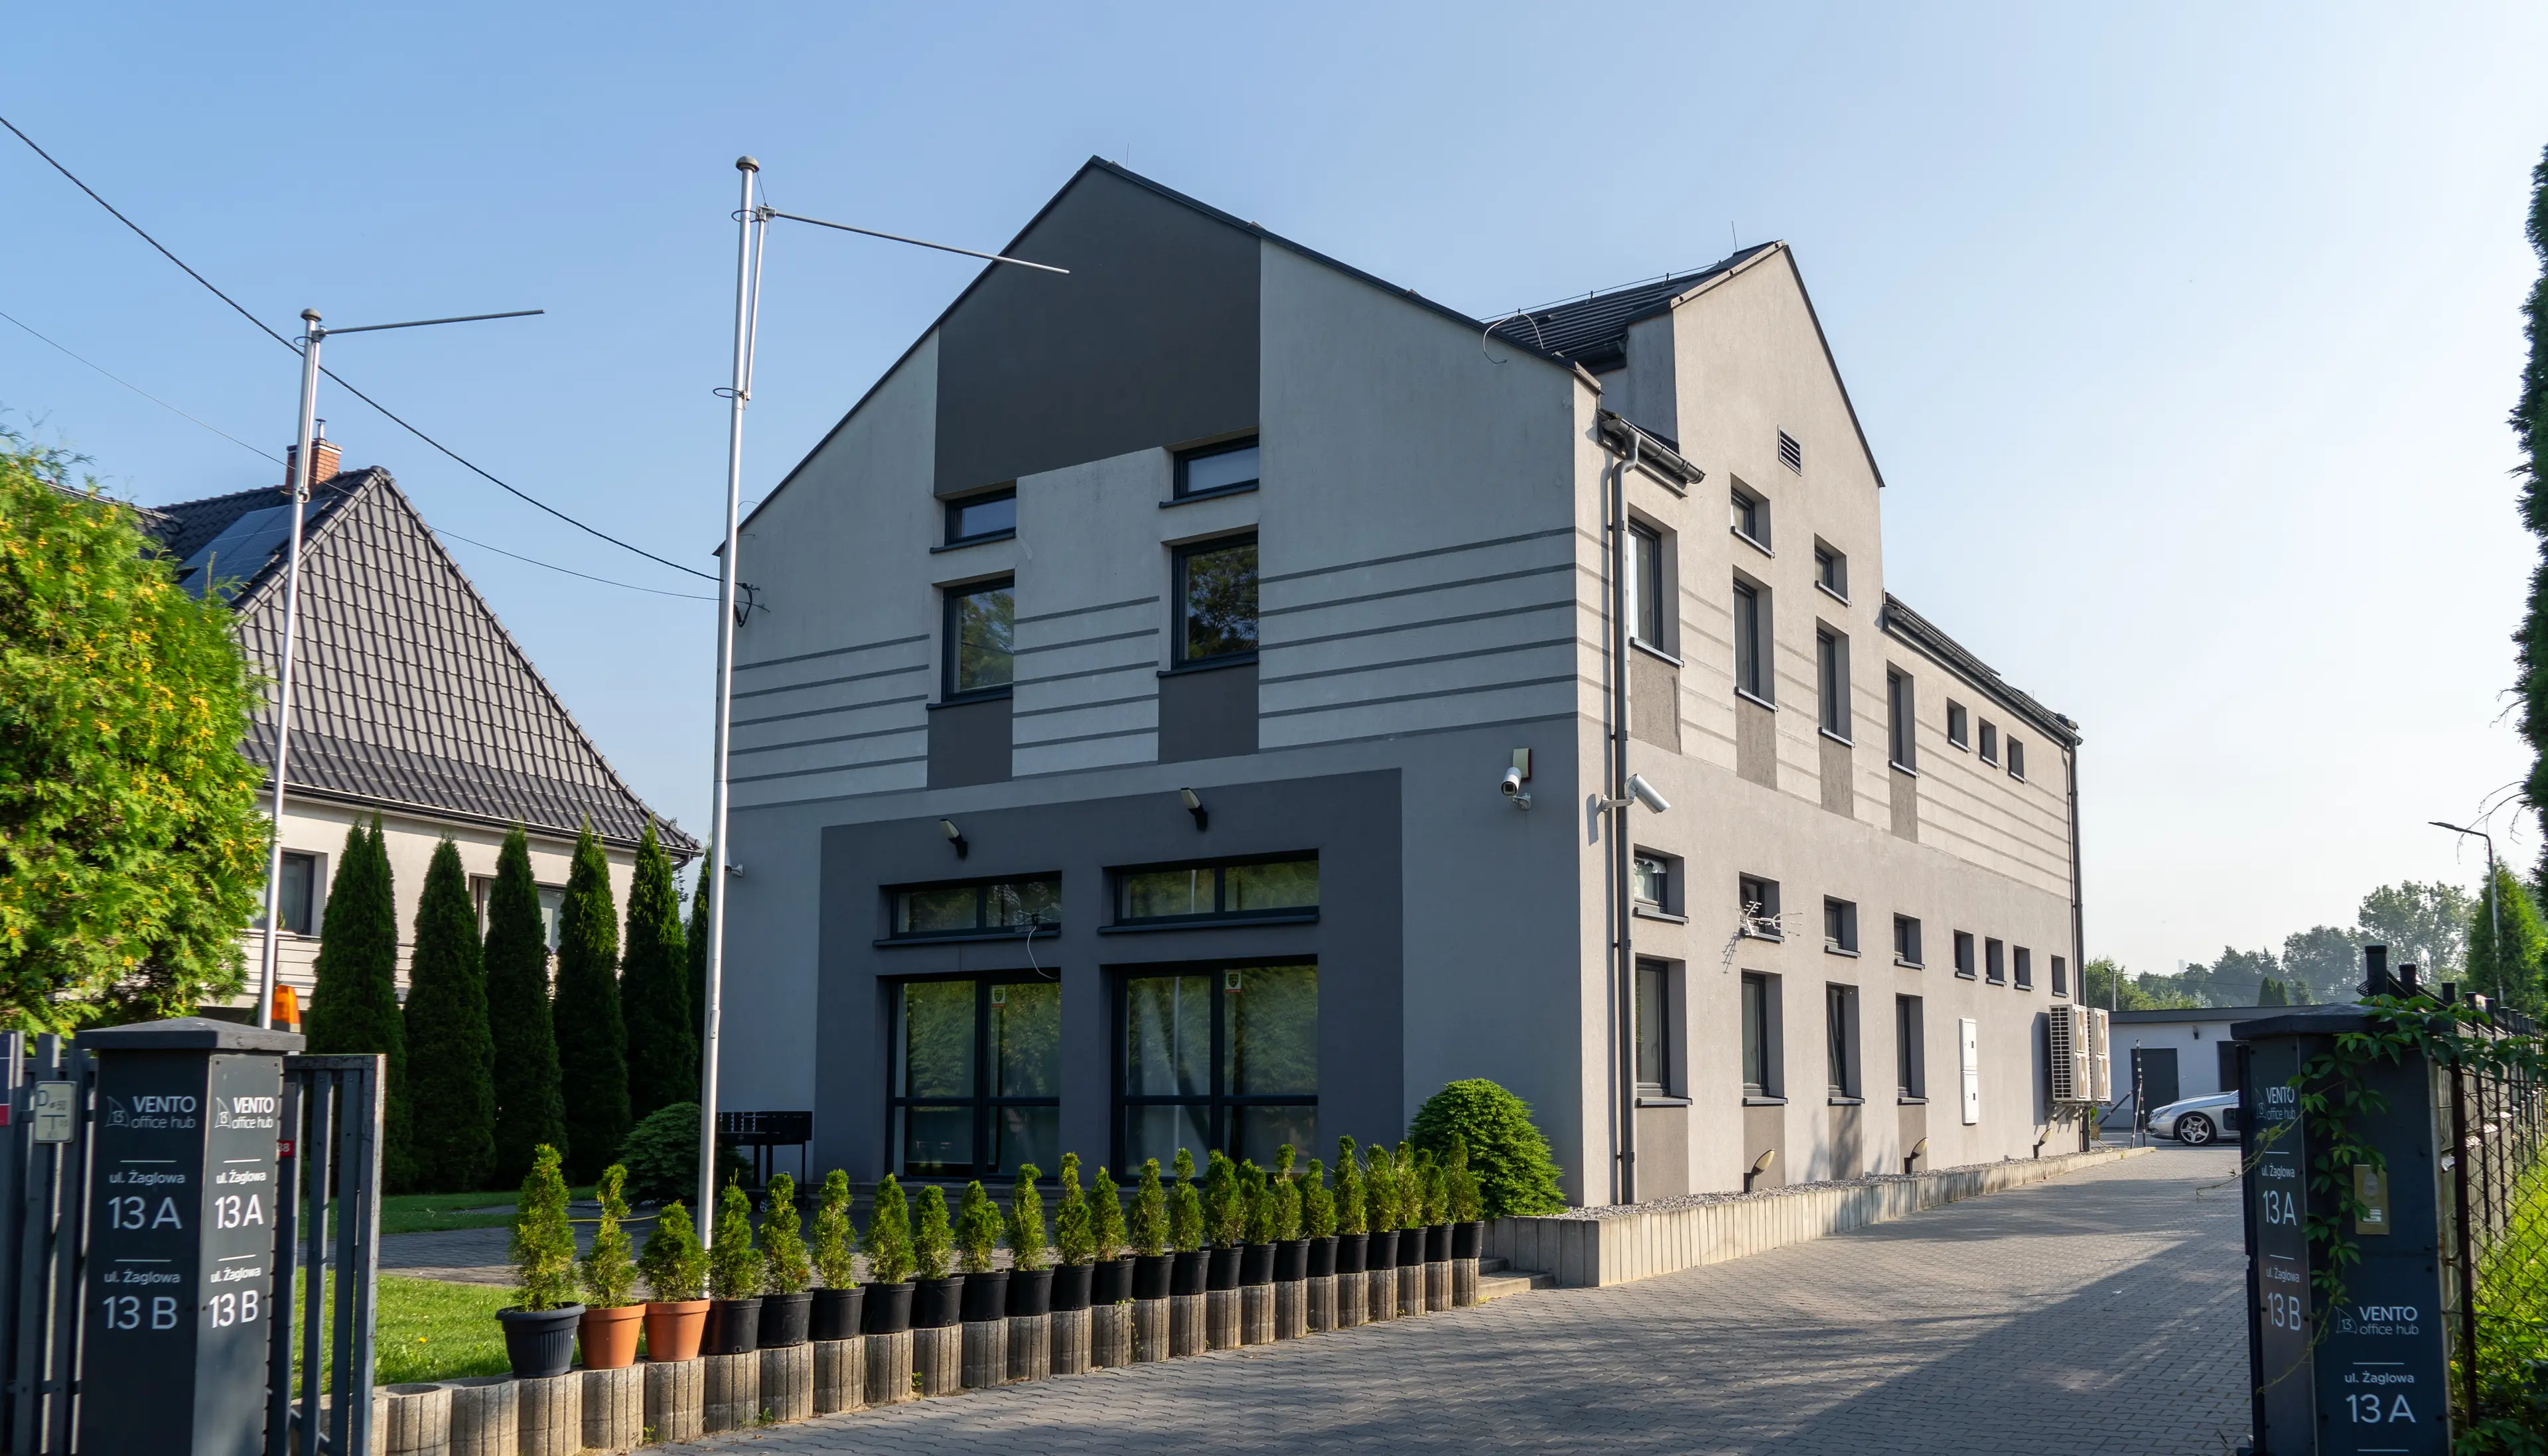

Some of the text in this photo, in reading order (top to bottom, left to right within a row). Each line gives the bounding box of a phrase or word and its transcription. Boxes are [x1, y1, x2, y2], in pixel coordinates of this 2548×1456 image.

[2265, 1086, 2295, 1104] VENTO
[133, 1096, 196, 1112] VENTO
[233, 1096, 275, 1114] VENTO
[111, 1110, 125, 1123] 13
[131, 1115, 196, 1128] office hub
[219, 1111, 229, 1124] 13
[2267, 1106, 2296, 1120] office hub
[232, 1116, 274, 1129] office hub
[109, 1169, 186, 1186] ul. Żaglowa
[216, 1169, 267, 1185] ul. Żaglowa
[2269, 1163, 2295, 1179] Żaglowa
[107, 1196, 183, 1229] 13 A
[214, 1193, 264, 1229] 13 A
[2263, 1190, 2297, 1226] 13 A
[104, 1268, 181, 1286] ul. Żaglowa
[210, 1266, 261, 1283] ul. Żaglowa
[2274, 1265, 2300, 1283] Żaglowa
[103, 1295, 178, 1330] 13 B
[209, 1290, 259, 1329] 13 B
[2267, 1292, 2301, 1331] 13 B
[2358, 1306, 2418, 1321] VENTO
[2341, 1319, 2352, 1330] 13
[2359, 1324, 2420, 1335] office hub
[2344, 1370, 2415, 1385] ul. Żaglowa
[2345, 1394, 2417, 1424] 13 A
